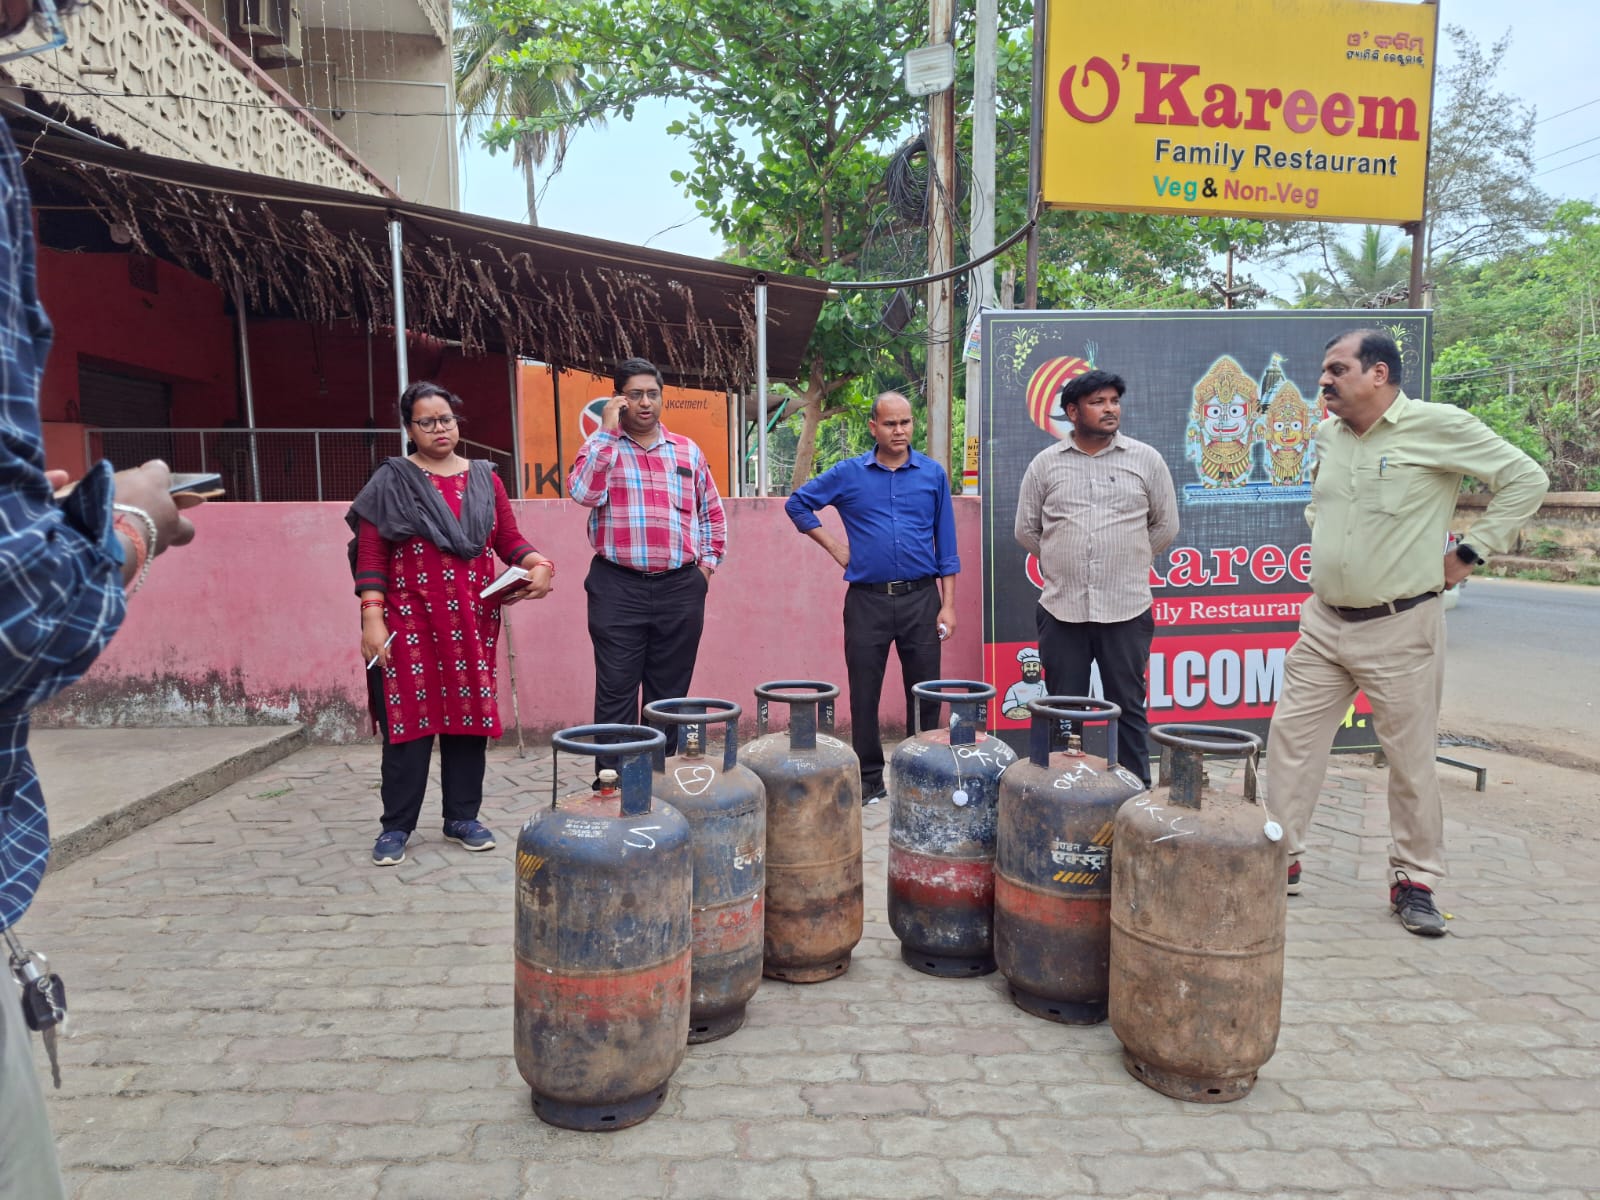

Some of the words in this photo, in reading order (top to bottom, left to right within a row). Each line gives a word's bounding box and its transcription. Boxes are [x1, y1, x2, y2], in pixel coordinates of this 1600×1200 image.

[1058, 53, 1420, 142] O'Kareem
[1155, 138, 1245, 172] Family
[1253, 145, 1398, 177] Restaurant
[1153, 175, 1197, 202] Veg
[1201, 177, 1219, 199] &
[1223, 179, 1319, 209] Non-Veg
[1189, 602, 1303, 620] Restauran
